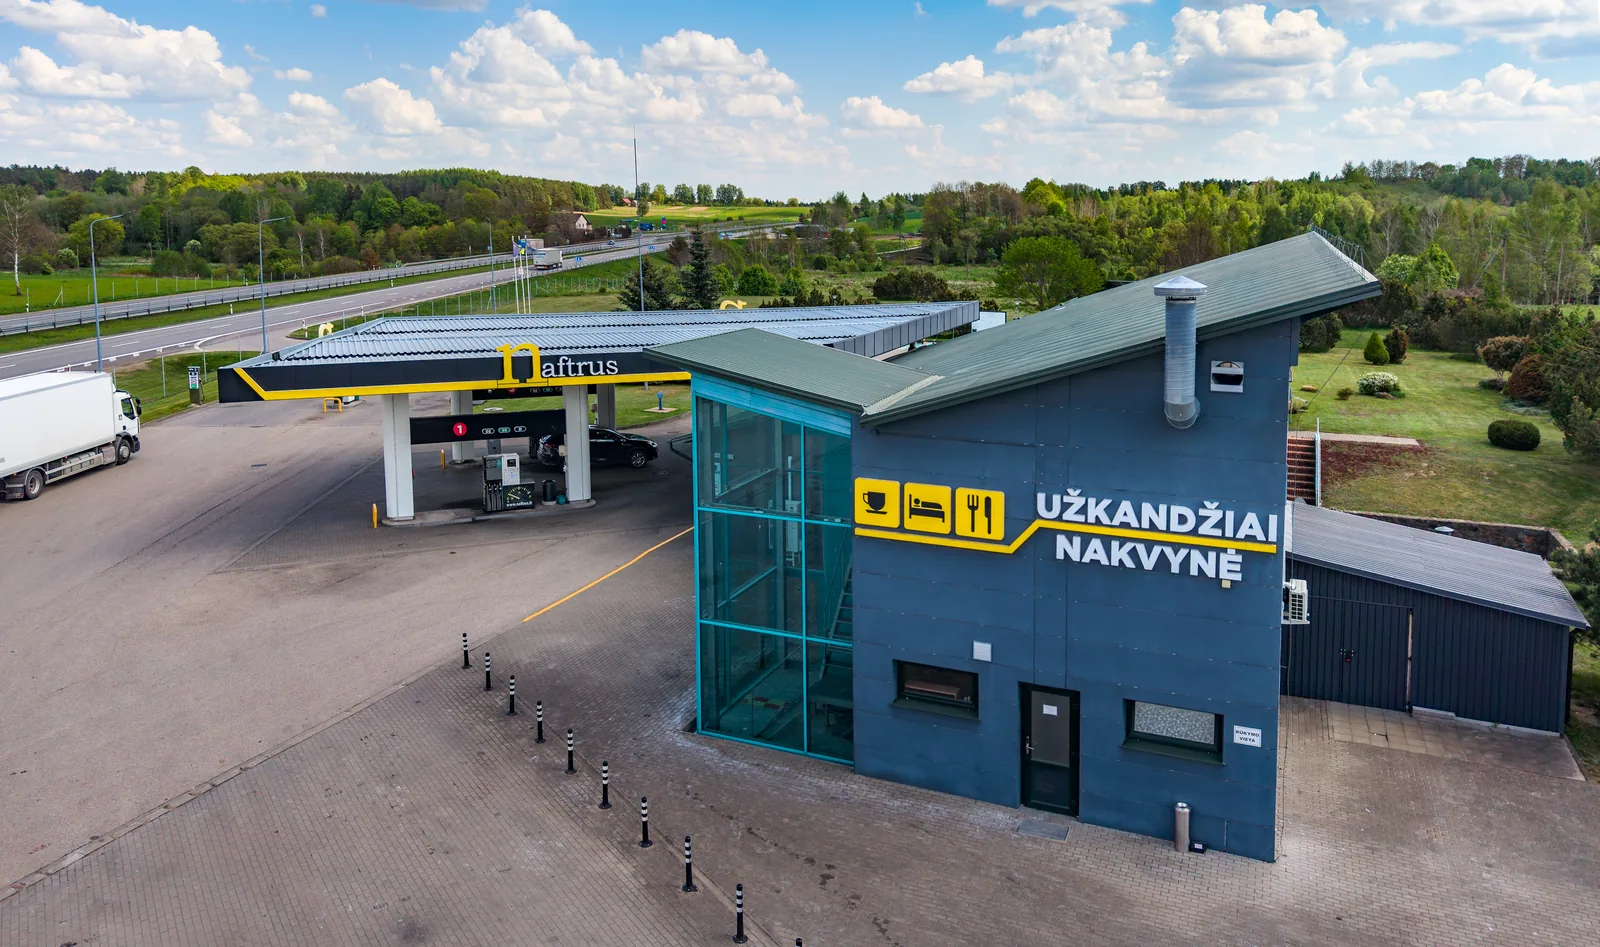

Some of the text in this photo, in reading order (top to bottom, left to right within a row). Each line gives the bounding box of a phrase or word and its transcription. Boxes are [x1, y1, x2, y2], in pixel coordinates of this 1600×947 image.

[496, 343, 619, 383] naftrus
[457, 425, 463, 434] 1
[1036, 488, 1278, 542] UŽKANDŽIAI
[1055, 534, 1242, 581] NAKVYNĖ
